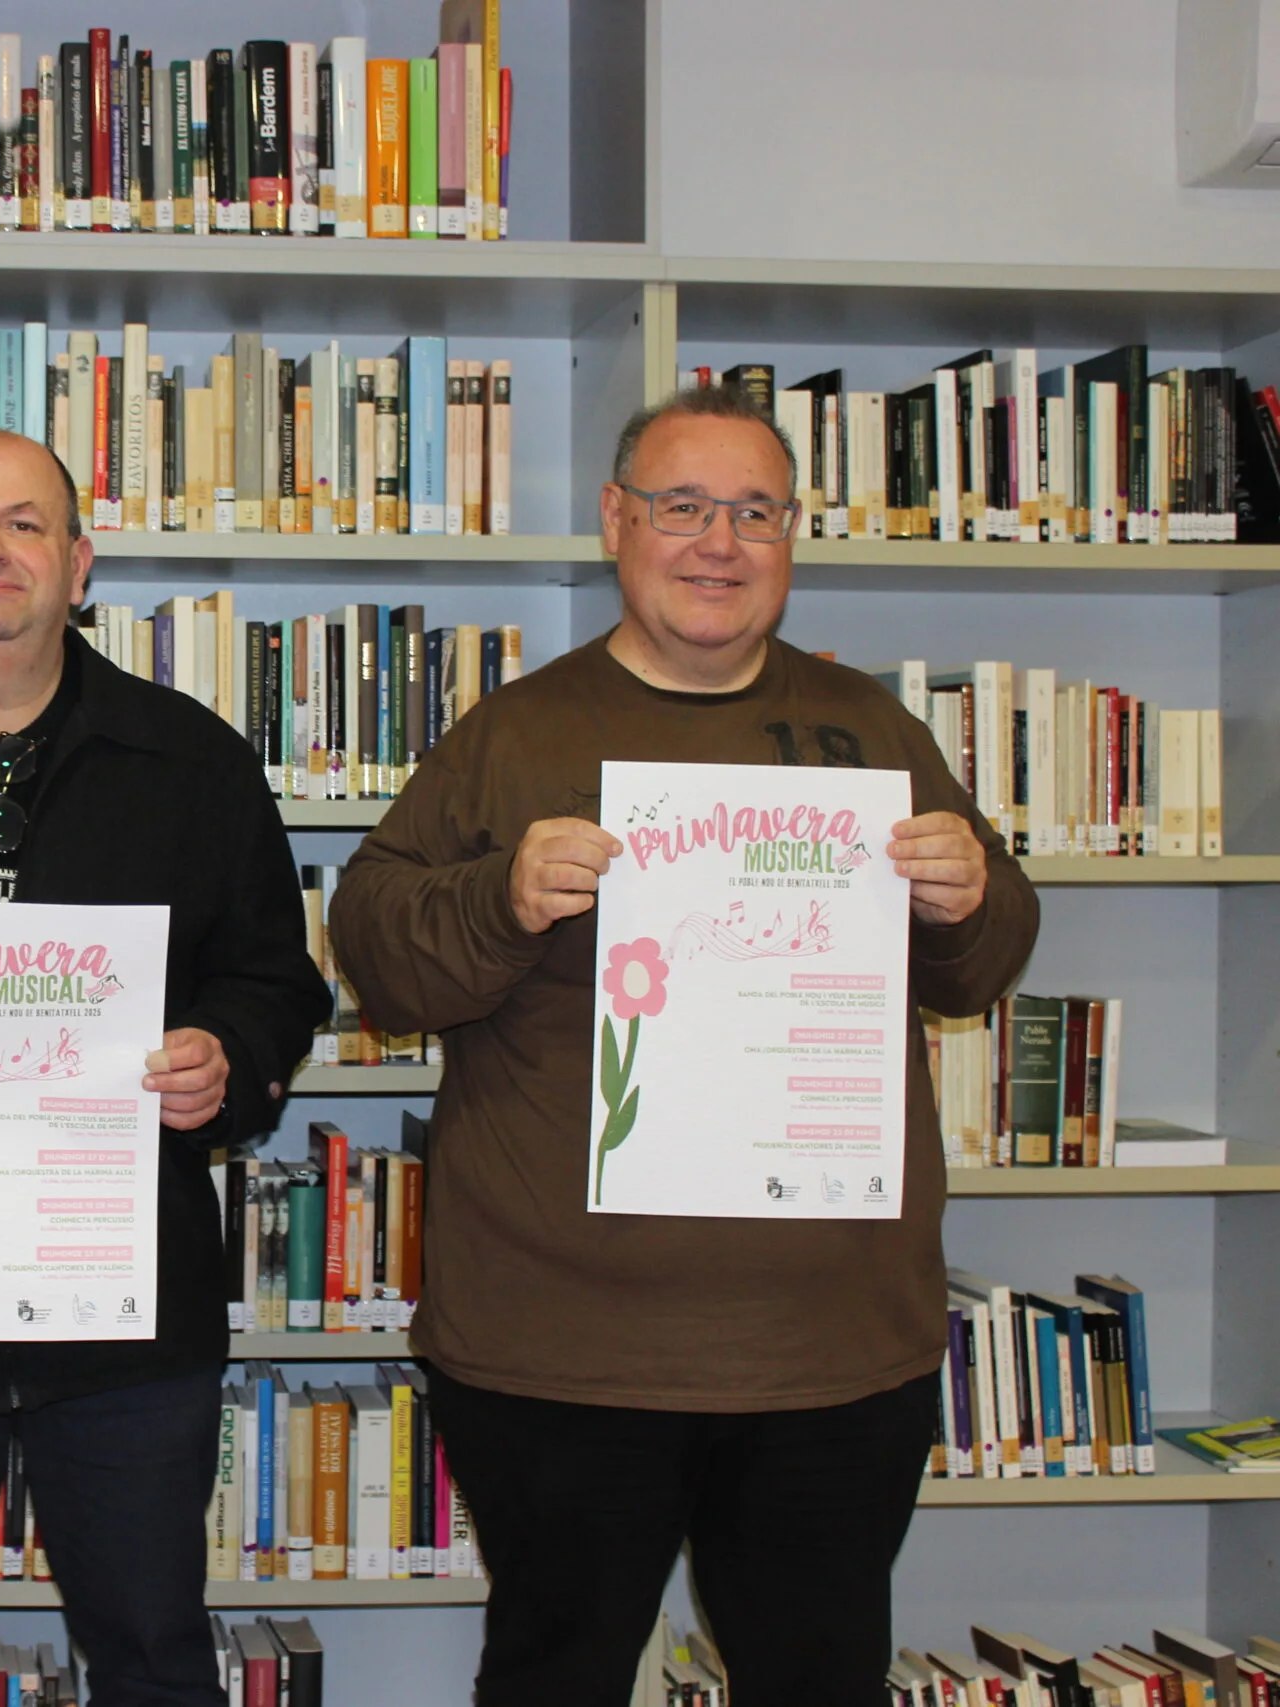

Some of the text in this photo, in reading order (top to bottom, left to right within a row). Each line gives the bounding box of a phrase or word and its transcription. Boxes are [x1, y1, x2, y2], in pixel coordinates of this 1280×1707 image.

[70, 54, 81, 77] nada
[70, 78, 81, 90] de
[176, 70, 188, 104] CALIFA
[71, 91, 83, 134] propósito
[258, 67, 277, 138] Bardem
[380, 65, 398, 143] BAUDELAIRE
[71, 134, 82, 142] A
[176, 138, 188, 151] EL
[72, 150, 82, 175] Allen
[111, 418, 120, 456] GRANDE
[127, 393, 143, 490] FAVORITOS
[283, 413, 293, 464] CHRISTIE
[627, 802, 861, 871] primavera
[745, 841, 835, 873] MUSICAL
[729, 877, 849, 888] EL POBLE NOU DE BENITATXELL 2025
[9, 1009, 22, 1017] NOU
[84, 1008, 101, 1016] 2025
[1023, 1023, 1048, 1036] Pablo
[1019, 1034, 1052, 1046] Neruda
[220, 1407, 234, 1485] POUND
[319, 1411, 328, 1473] JEAN-JACQUES
[328, 1412, 341, 1474] ROUSSEAU
